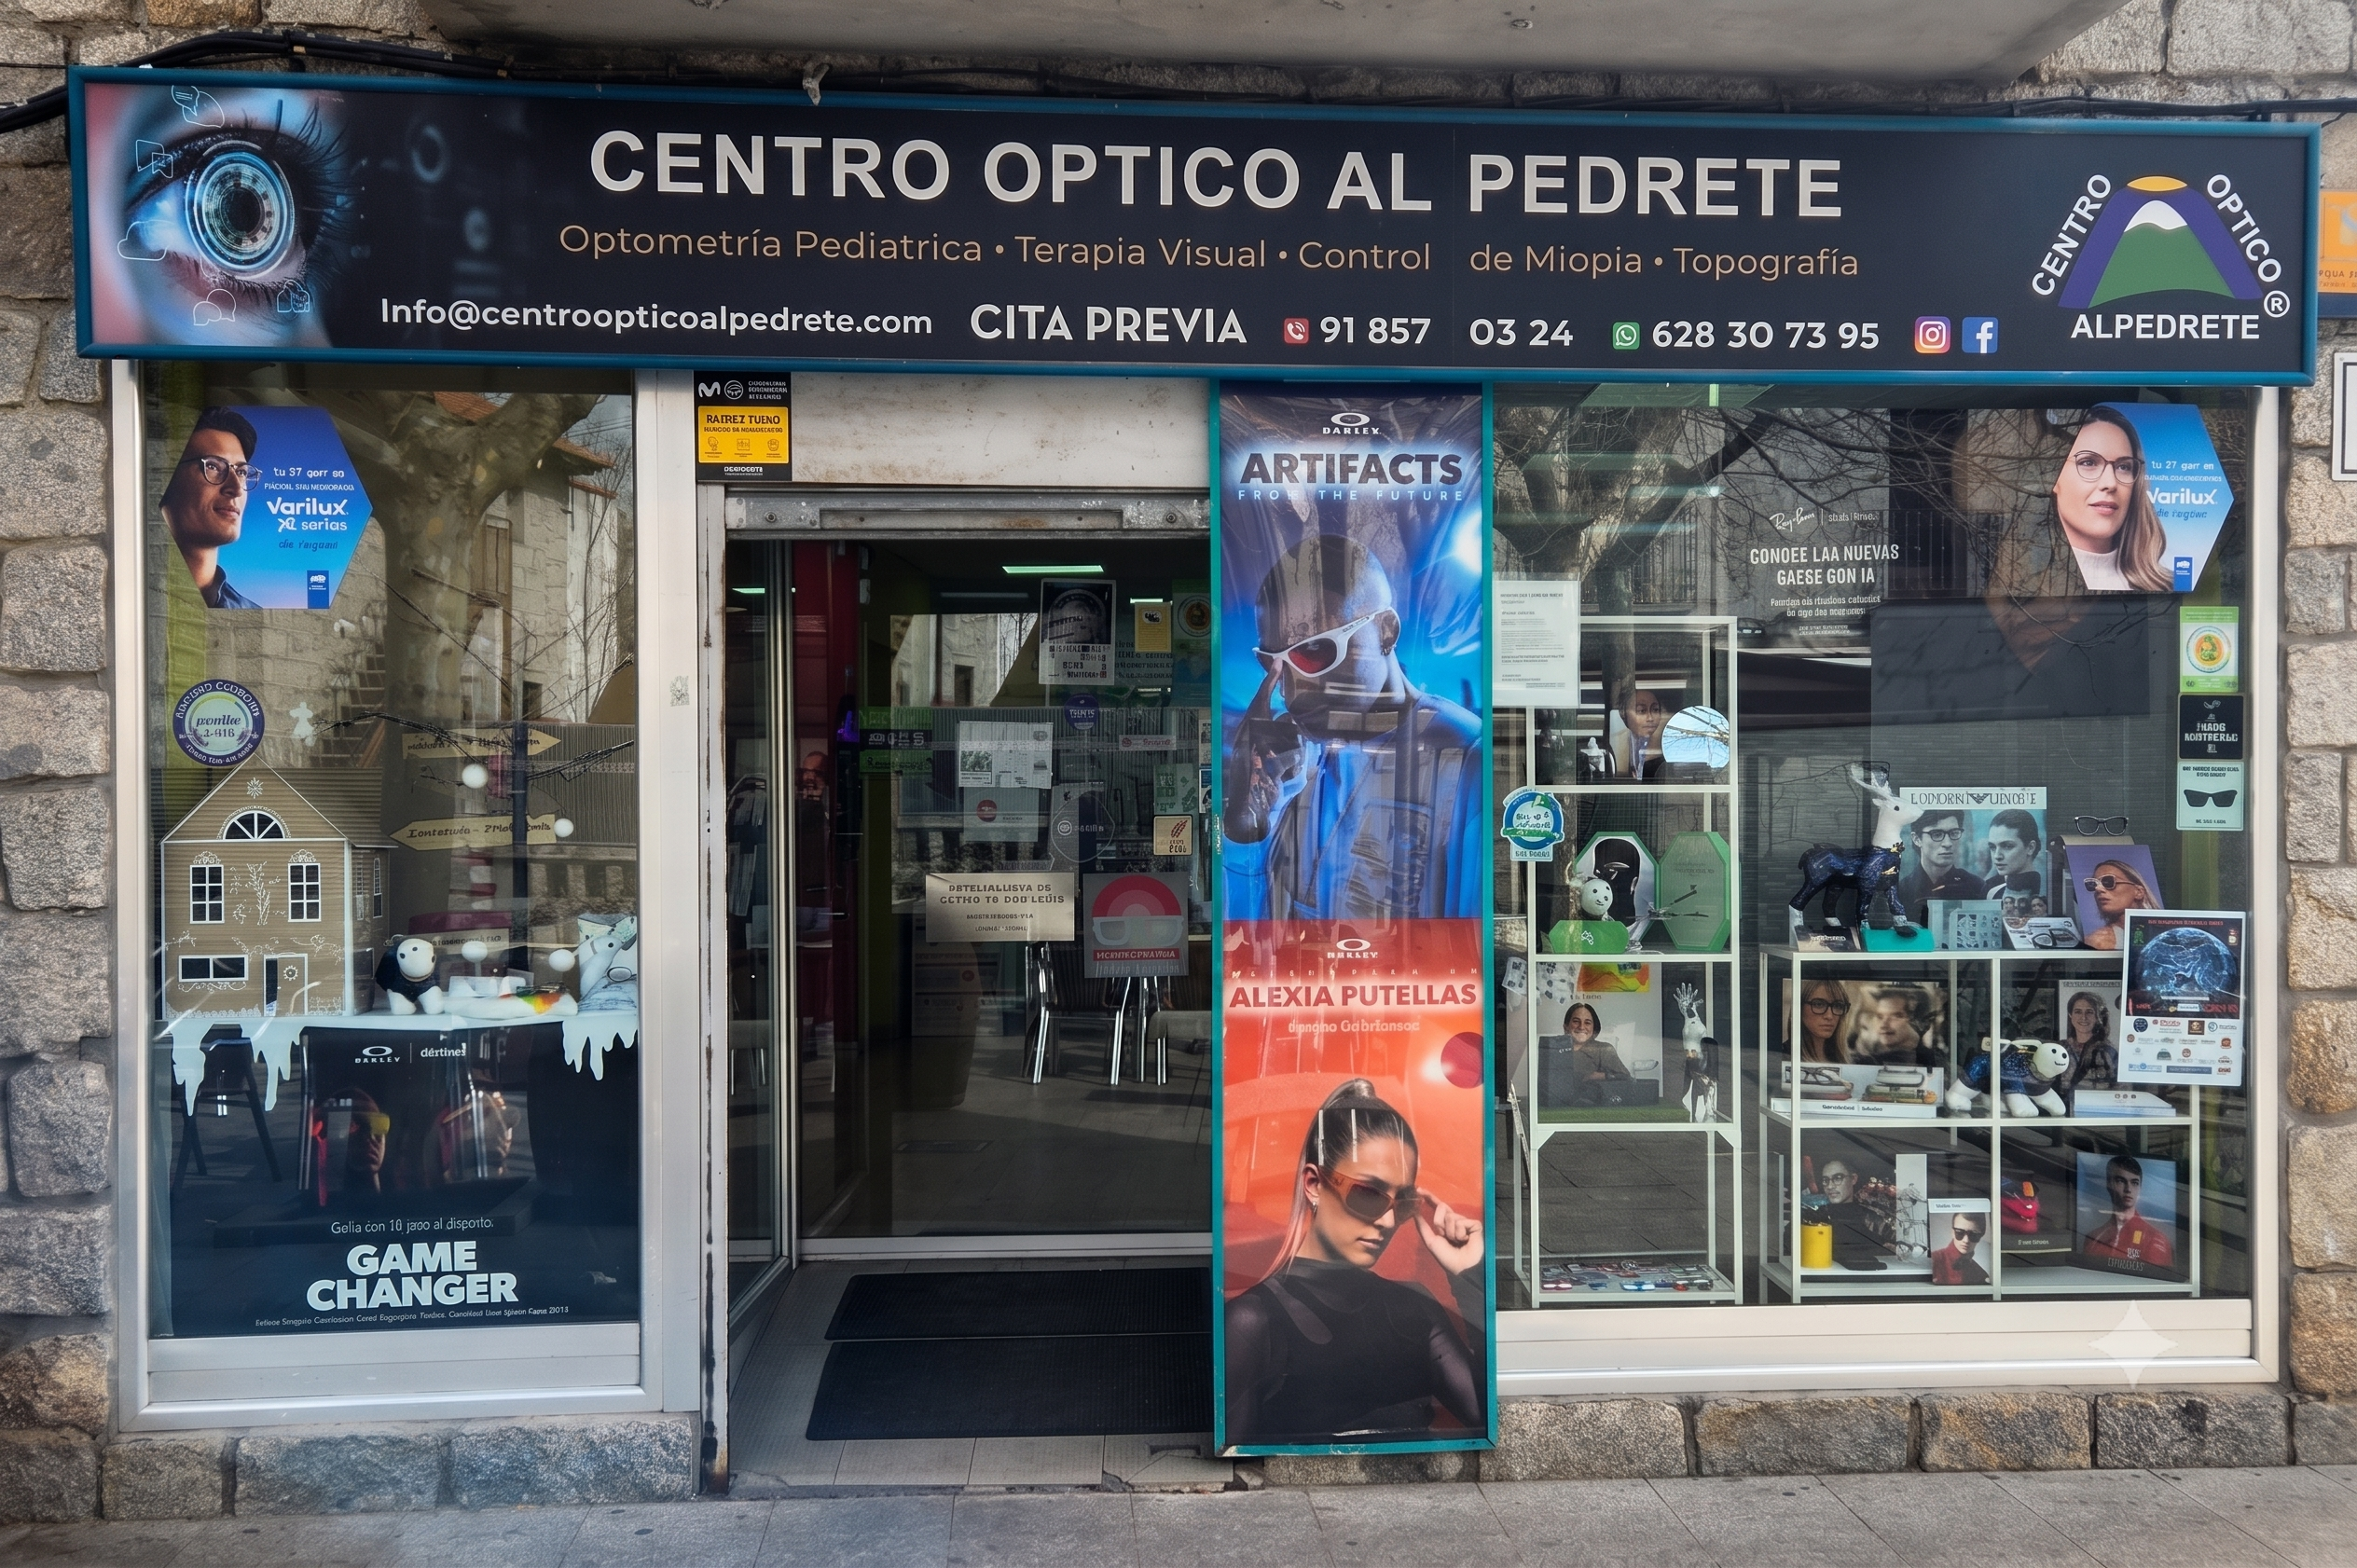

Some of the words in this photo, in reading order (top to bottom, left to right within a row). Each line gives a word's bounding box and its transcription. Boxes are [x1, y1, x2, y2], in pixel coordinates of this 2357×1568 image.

[590, 130, 950, 201] CENTRO
[984, 142, 1300, 209] OPTICO
[1327, 151, 1432, 211] AL
[1469, 154, 1841, 217] PEDRETE
[2032, 174, 2111, 296] CENTRO
[2207, 174, 2281, 282] OPTICO
[559, 225, 780, 260] Optometría
[796, 230, 981, 262] Pediatrica
[1014, 236, 1145, 271] Terapia
[1158, 238, 1265, 268] Visual
[1299, 241, 1429, 270] Control
[1470, 243, 1513, 271] de
[1526, 245, 1641, 280] Miopia
[1673, 245, 1857, 282] Topografía
[381, 298, 932, 337] Info@centroopticoalpedrete.com
[971, 303, 1073, 341] CITA
[1086, 306, 1247, 343] PREVIA
[1320, 316, 1354, 343] 91
[1368, 317, 1431, 345] 857
[1469, 318, 1516, 346] 03
[1529, 319, 1574, 347] 24
[2070, 313, 2260, 339] ALPEDRETE
[1652, 321, 1715, 348] 628
[1727, 321, 1773, 349] 30
[1785, 322, 1826, 349] 73
[1838, 322, 1880, 350] 95
[1239, 453, 1463, 486] ARTIFACTS
[266, 496, 349, 516] Varilux
[1318, 489, 1358, 501] THE
[1376, 489, 1463, 502] FUTURE
[2145, 487, 2218, 505] Varilux
[1843, 543, 1899, 561] NUEVAS
[1229, 985, 1334, 1008] ALEXIA
[1341, 983, 1477, 1007] PUTELLAS
[346, 1240, 477, 1276] GAME
[306, 1272, 519, 1312] CHANGER
